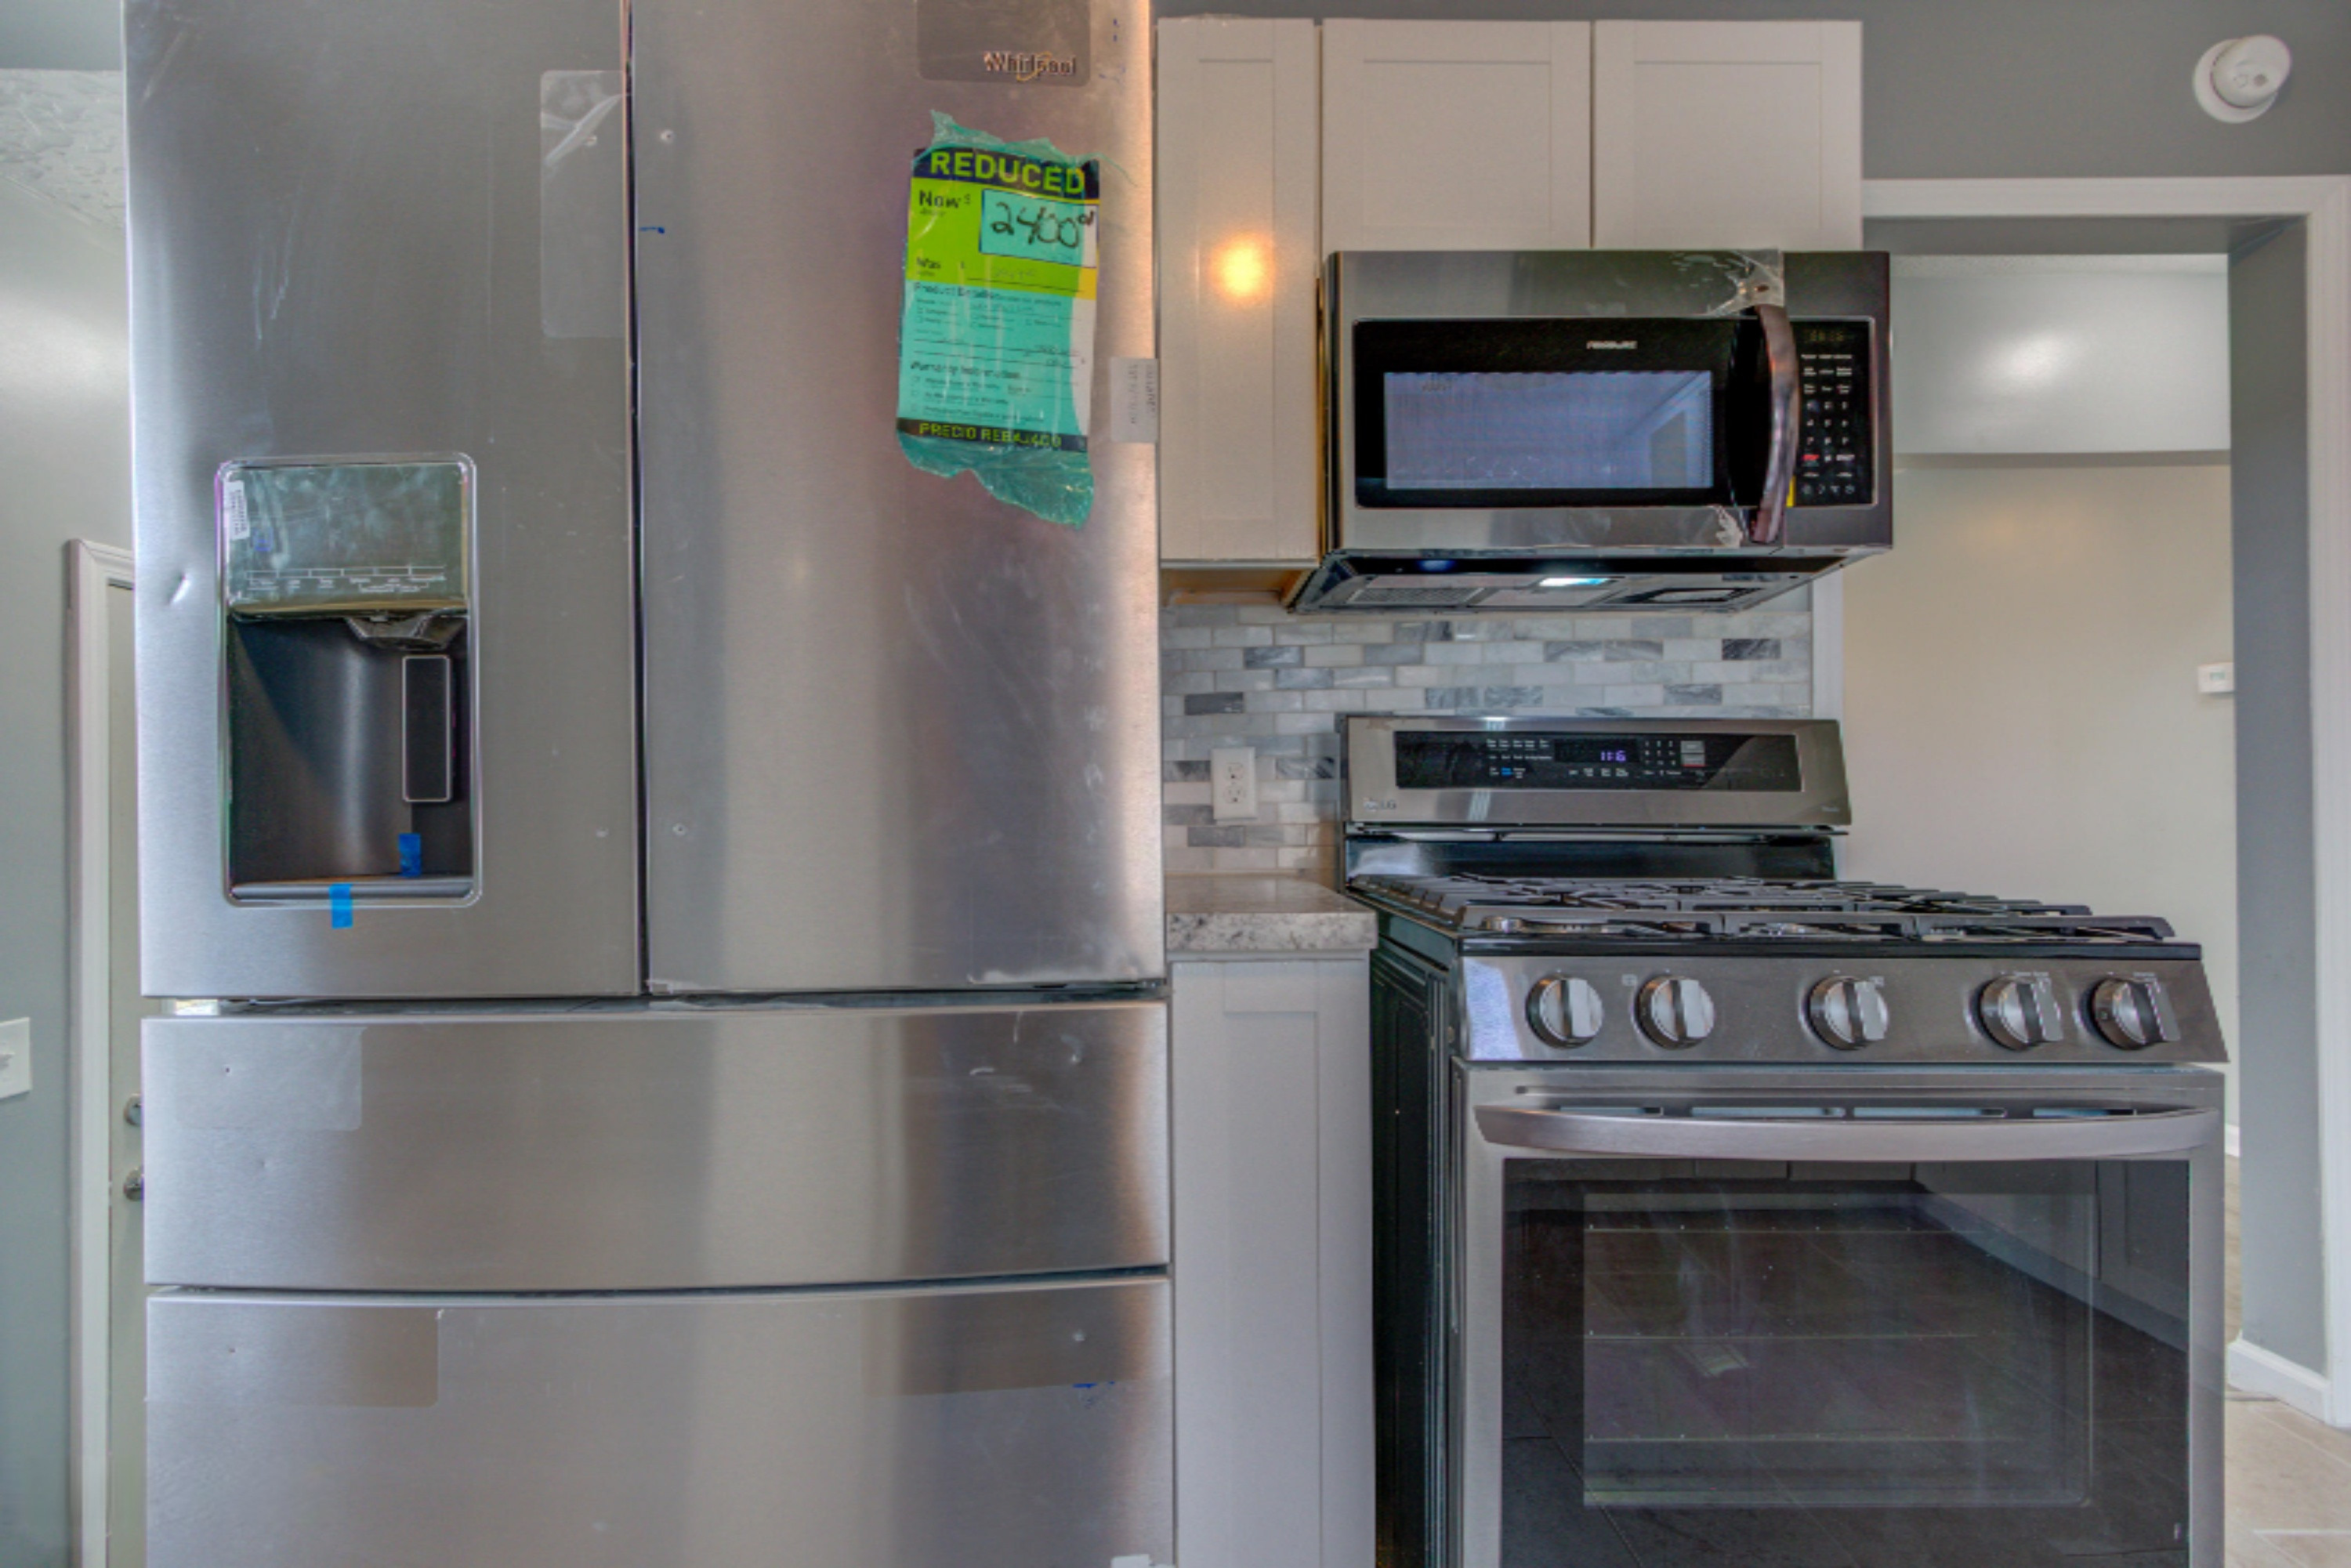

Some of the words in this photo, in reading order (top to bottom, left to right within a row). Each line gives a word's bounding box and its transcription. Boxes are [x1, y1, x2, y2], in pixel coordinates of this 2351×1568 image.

[984, 51, 1077, 78] Whirlpool
[929, 151, 1085, 194] REDUCED
[918, 422, 977, 440] PRECIO
